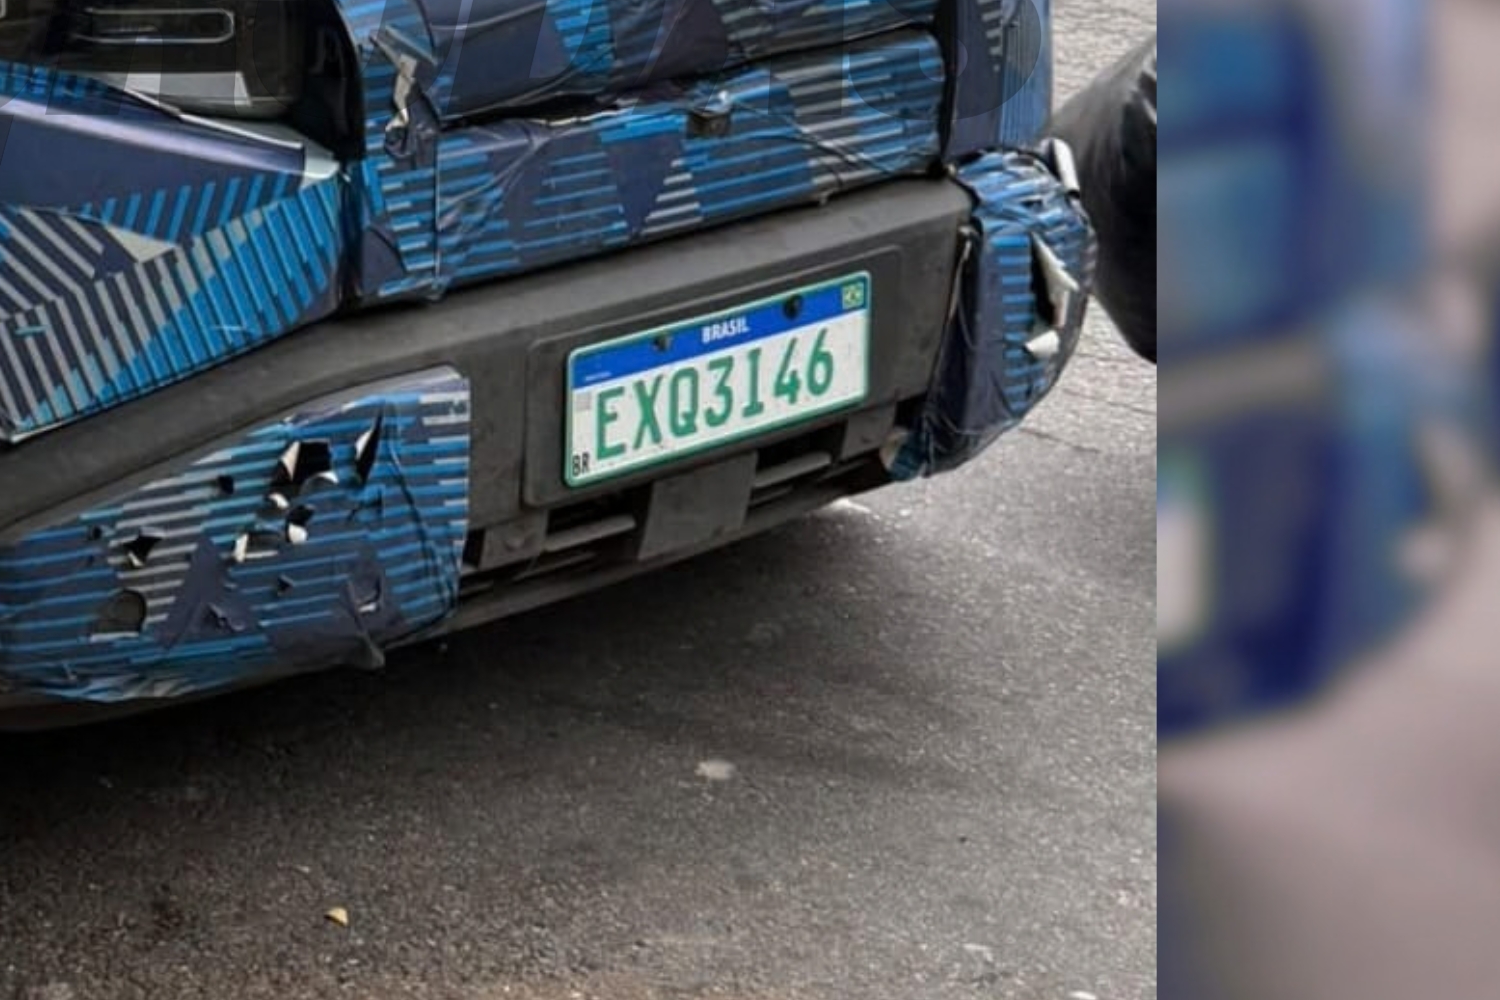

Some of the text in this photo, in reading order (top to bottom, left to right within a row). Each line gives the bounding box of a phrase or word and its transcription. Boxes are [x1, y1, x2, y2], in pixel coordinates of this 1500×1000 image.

[702, 317, 750, 344] BRASIL
[596, 328, 835, 461] EXQ3I46
[572, 451, 590, 477] BR
